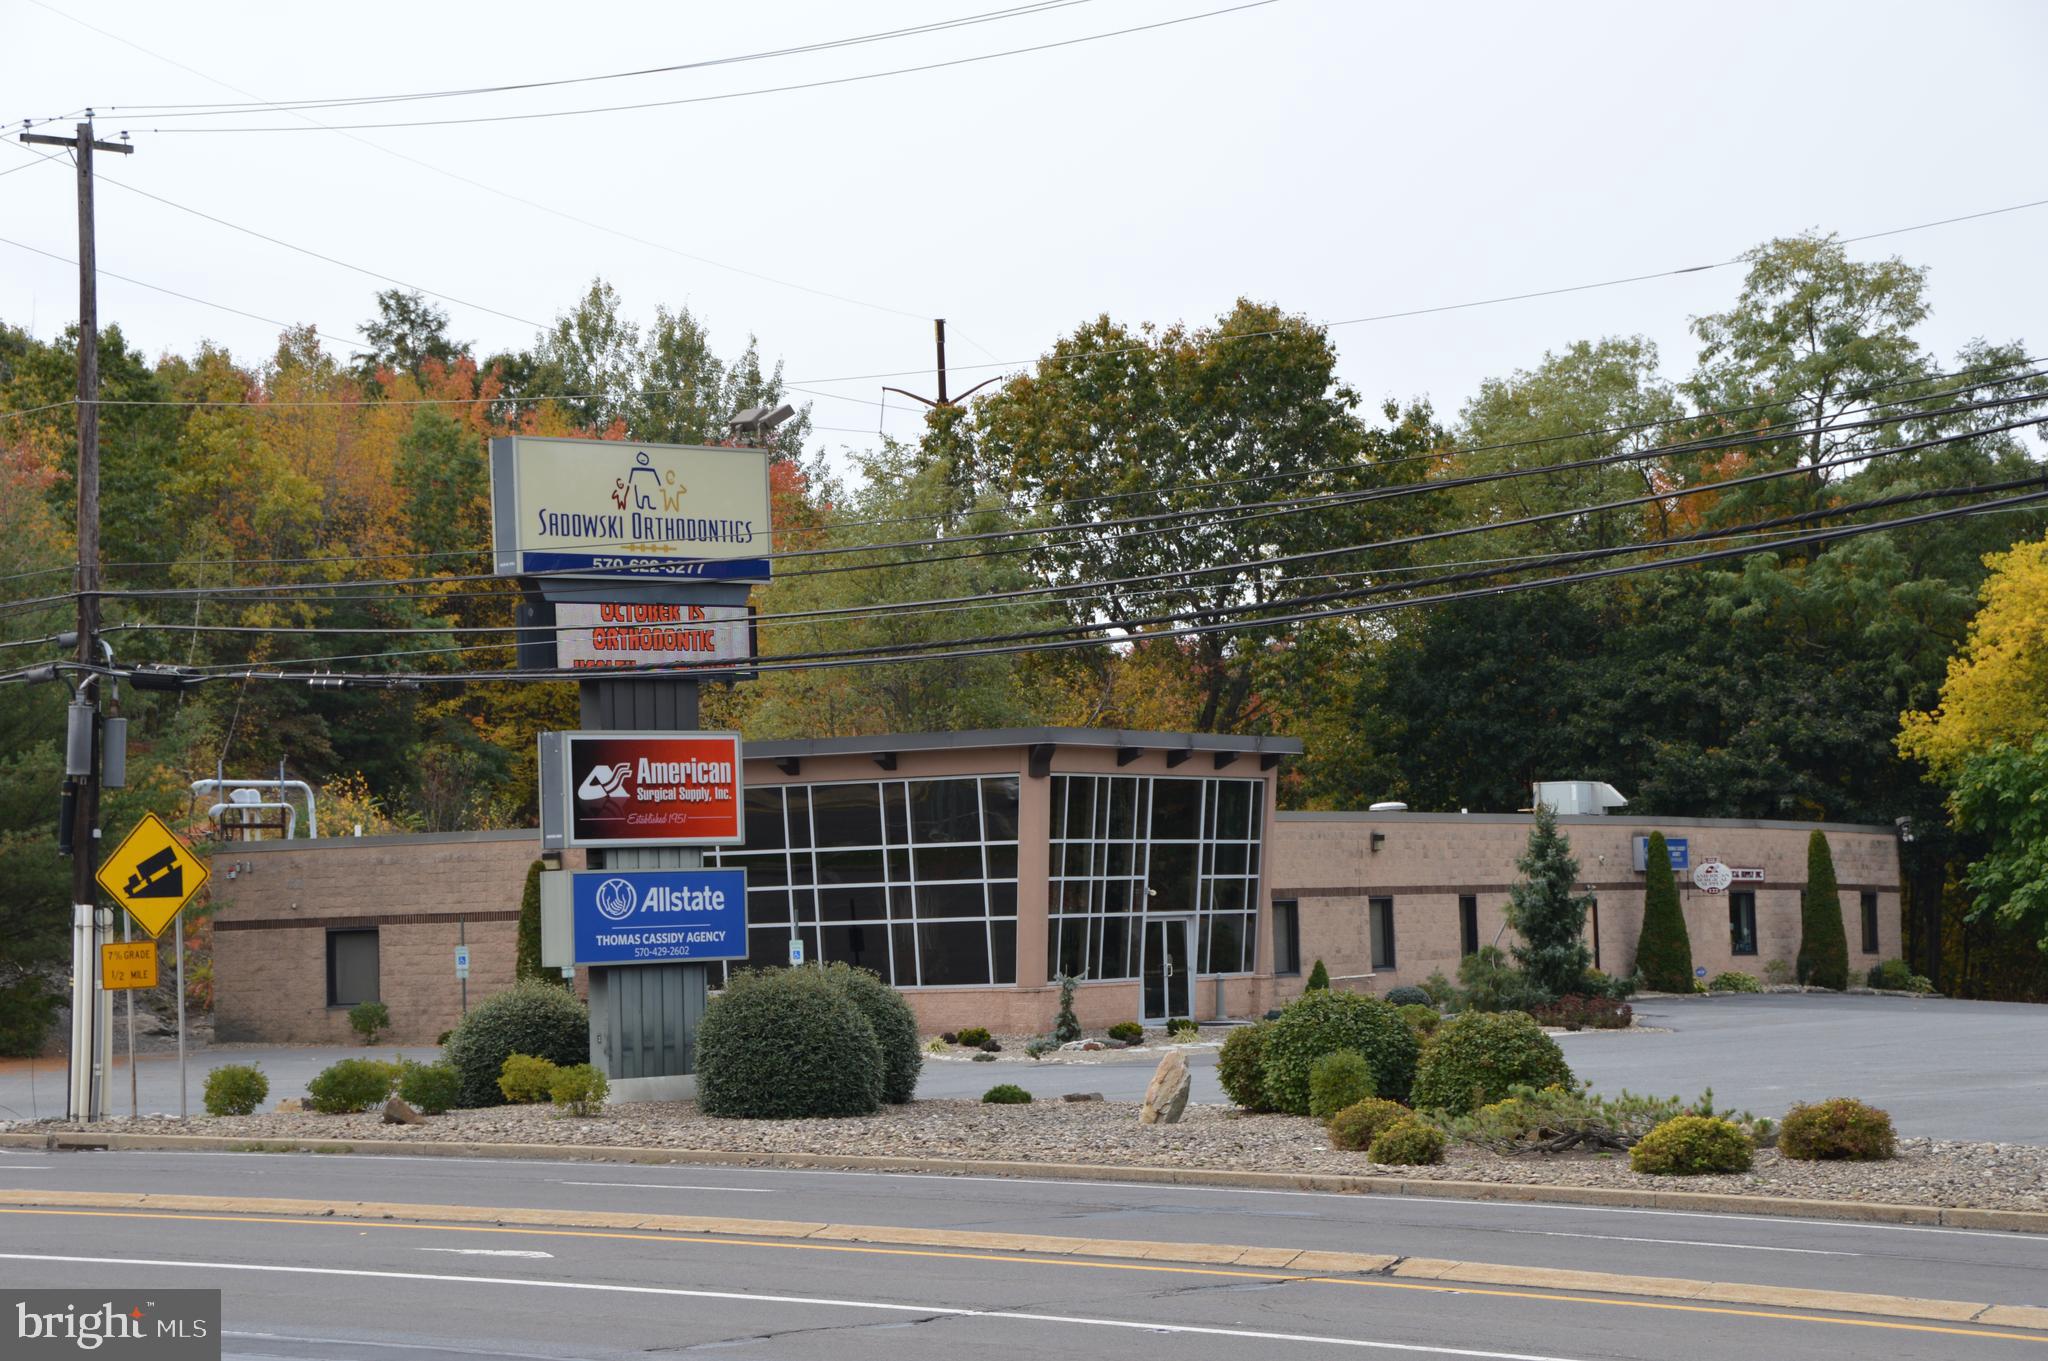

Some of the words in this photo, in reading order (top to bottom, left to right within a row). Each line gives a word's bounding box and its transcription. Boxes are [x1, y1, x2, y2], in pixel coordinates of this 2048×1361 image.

[538, 508, 624, 539] SADOWSKI
[632, 512, 753, 544] ORTHODONTICS
[600, 603, 681, 623] OCTOBER
[592, 627, 716, 652] ORTHODONTIC
[636, 757, 732, 785] American
[636, 786, 677, 803] Surgical
[679, 787, 712, 803] Supply,
[714, 786, 732, 801] Inc.
[626, 813, 667, 825] Established
[668, 812, 687, 824] 1951
[640, 885, 725, 913] Allstate
[595, 934, 641, 947] THOMAS
[642, 932, 685, 946] CASSIDY
[686, 930, 727, 944] AGENCY
[123, 949, 151, 960] GRADE
[634, 946, 690, 958] 570-429-2602
[111, 969, 125, 981] 1/2
[130, 969, 149, 980] MILE
